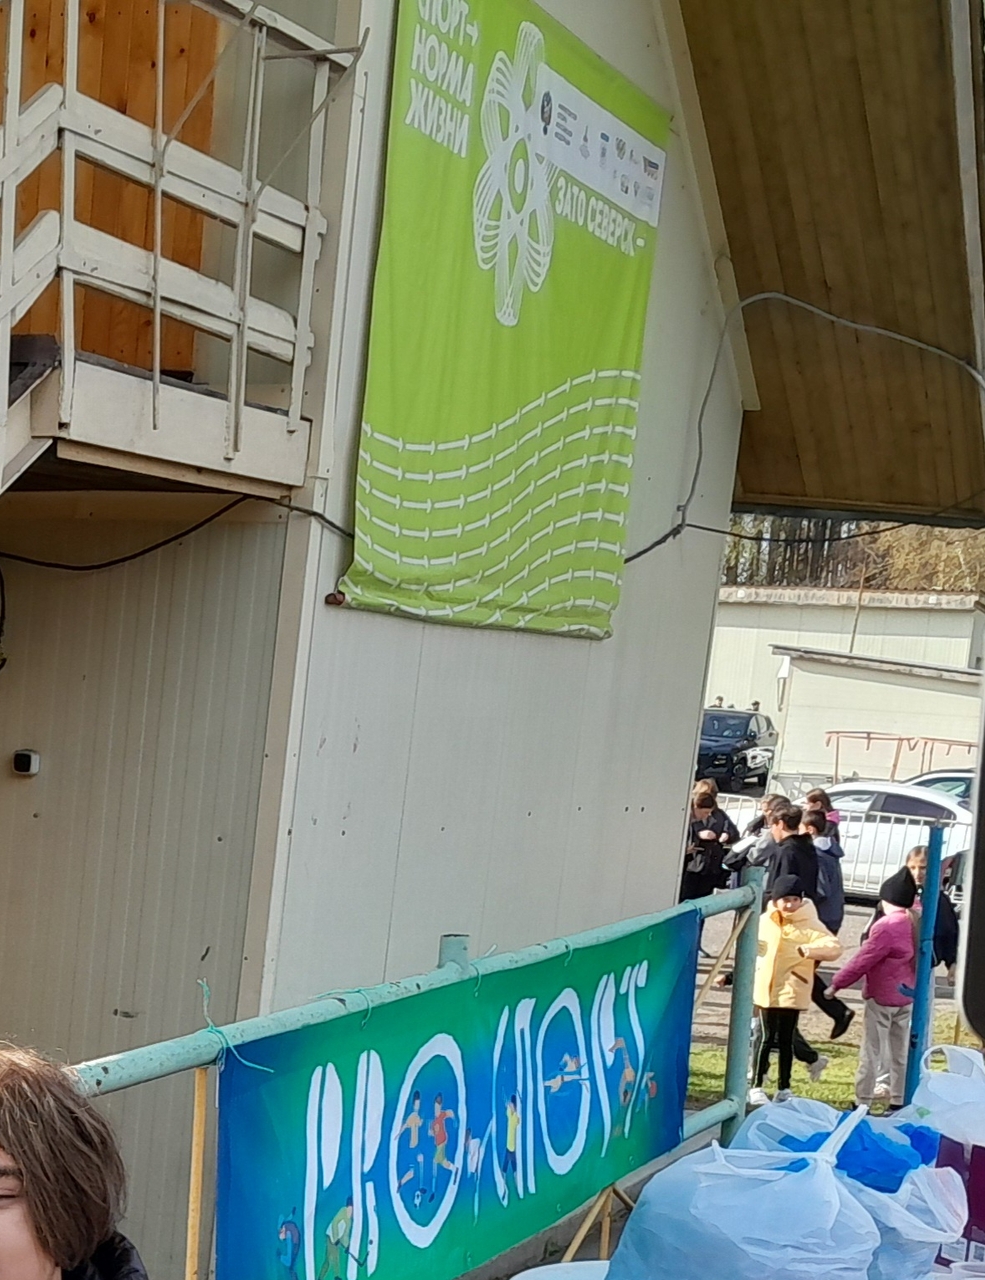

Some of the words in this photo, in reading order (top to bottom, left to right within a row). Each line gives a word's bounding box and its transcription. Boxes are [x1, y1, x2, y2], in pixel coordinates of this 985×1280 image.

[411, 23, 474, 107] НОРМА
[405, 77, 470, 158] ЖИЗНИ
[555, 175, 587, 226] ЗАТО
[586, 196, 635, 257] СЕВЕРСК
